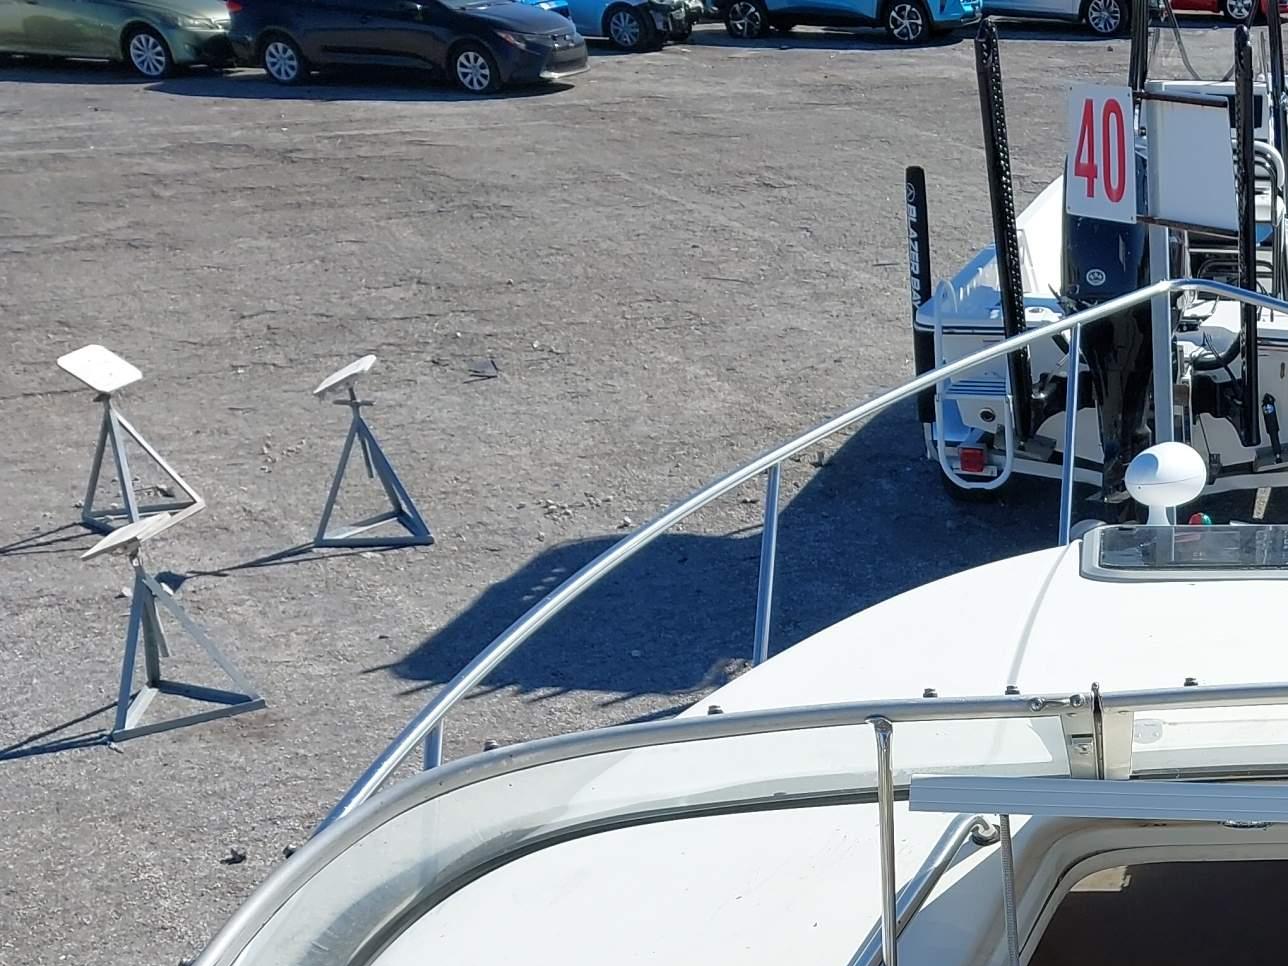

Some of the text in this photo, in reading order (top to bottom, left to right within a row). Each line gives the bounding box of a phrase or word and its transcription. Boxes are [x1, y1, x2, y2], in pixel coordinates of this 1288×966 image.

[1075, 98, 1126, 203] 40
[906, 203, 923, 310] BLAZER BAY
